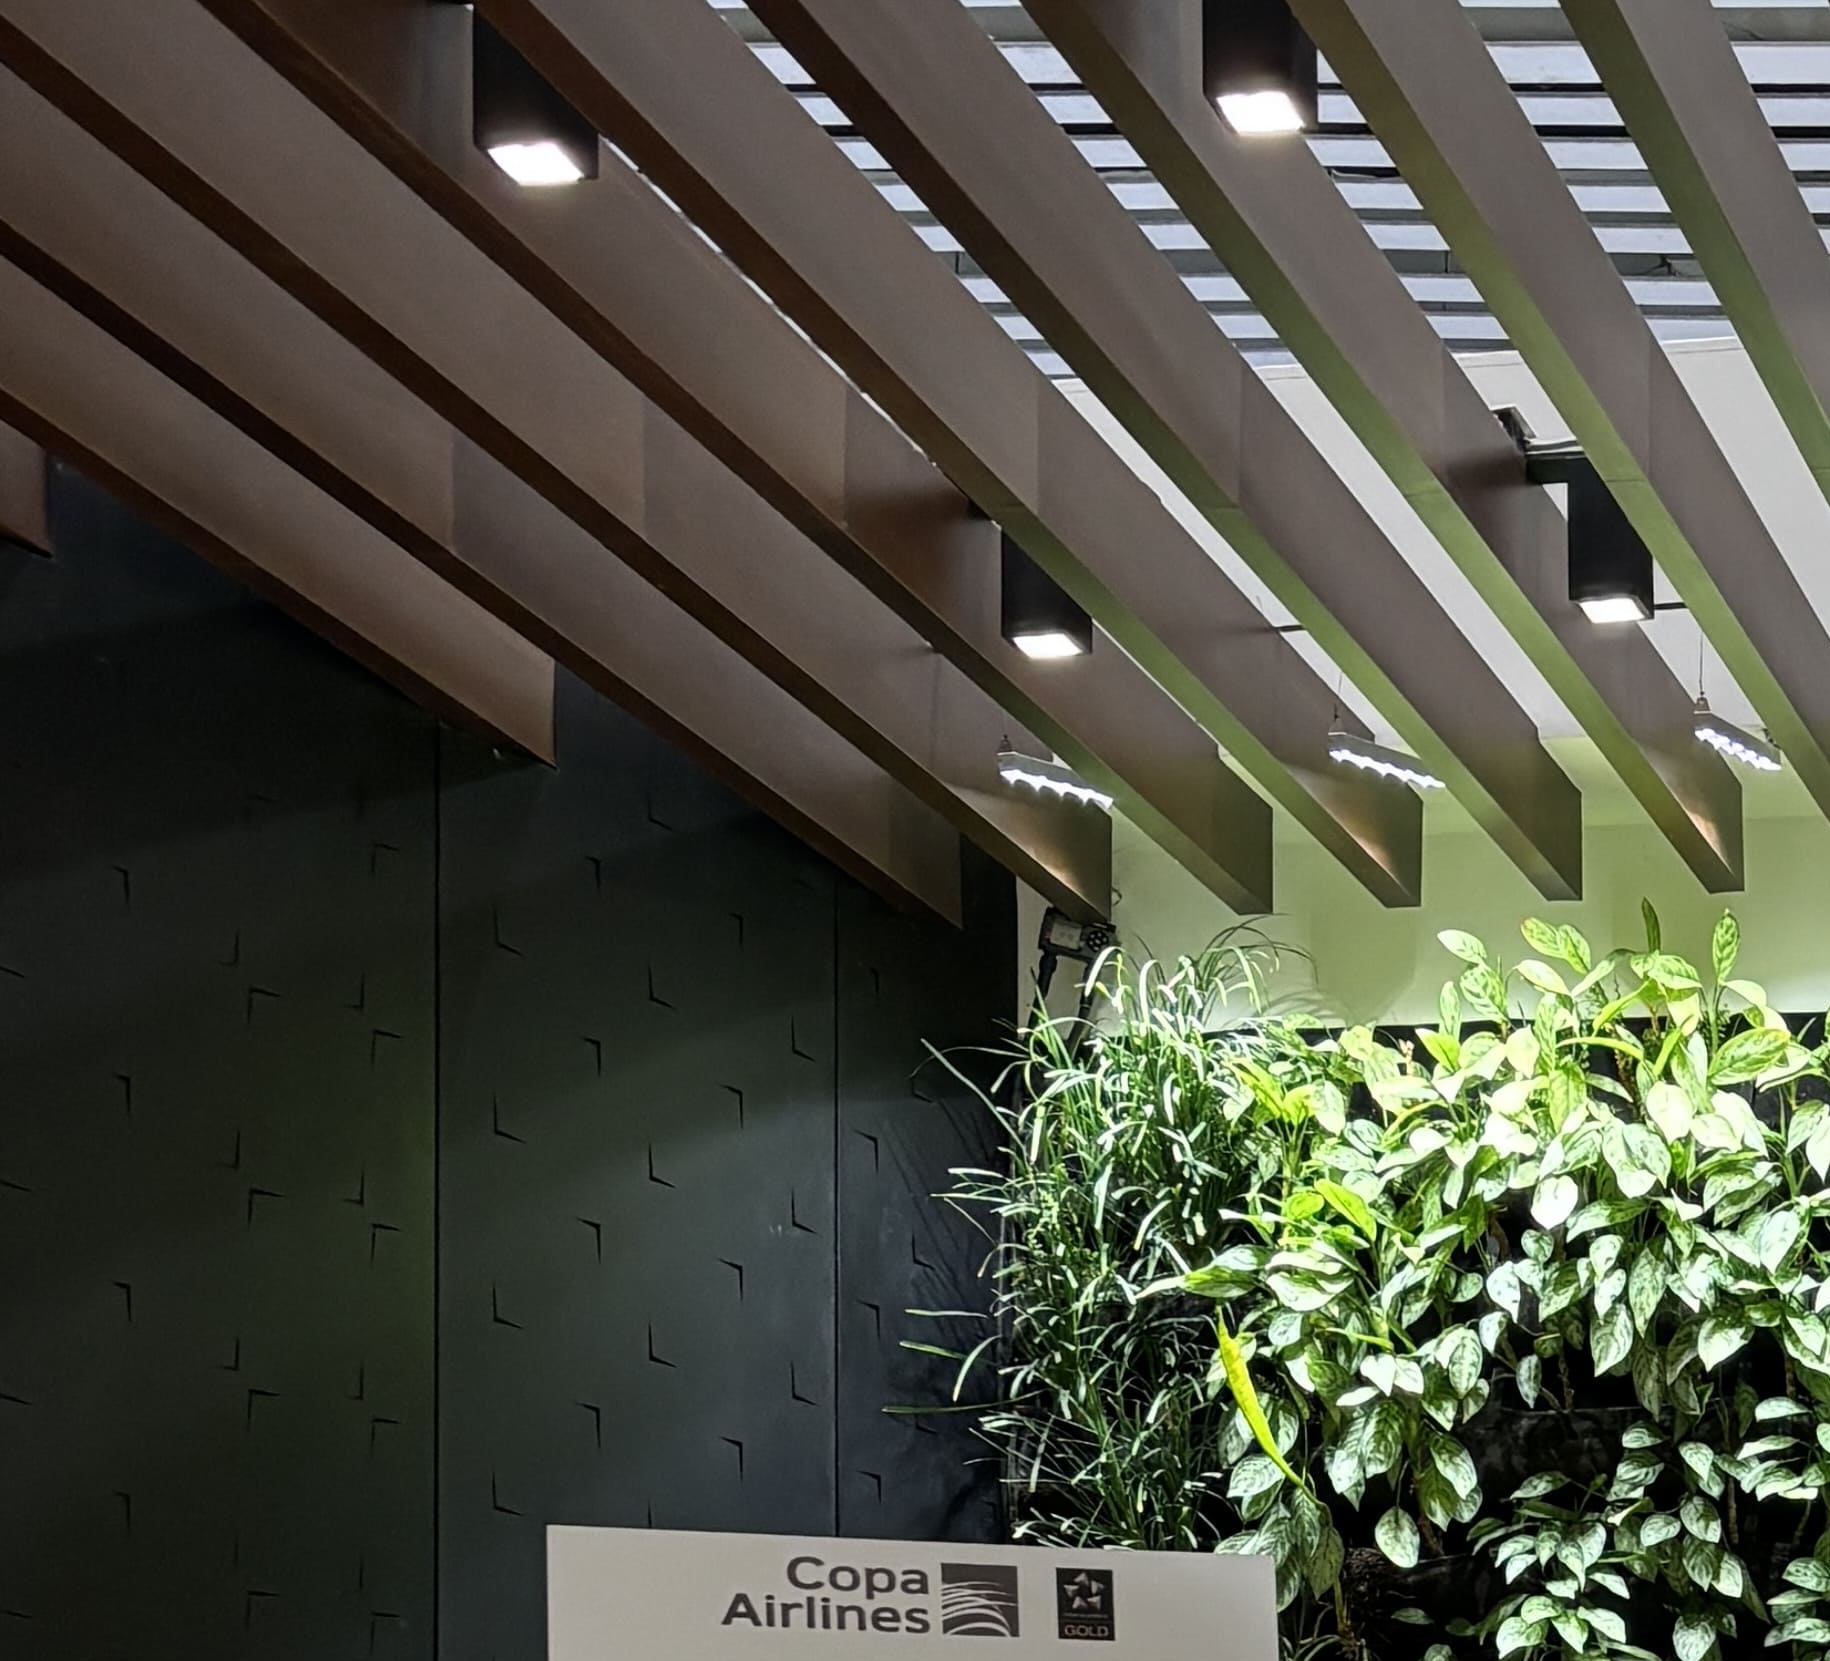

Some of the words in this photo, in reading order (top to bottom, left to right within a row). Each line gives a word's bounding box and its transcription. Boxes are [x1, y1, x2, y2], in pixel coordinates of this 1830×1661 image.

[786, 1555, 930, 1600] Copa
[721, 1592, 931, 1635] Airlines
[1064, 1624, 1109, 1637] GOLD
